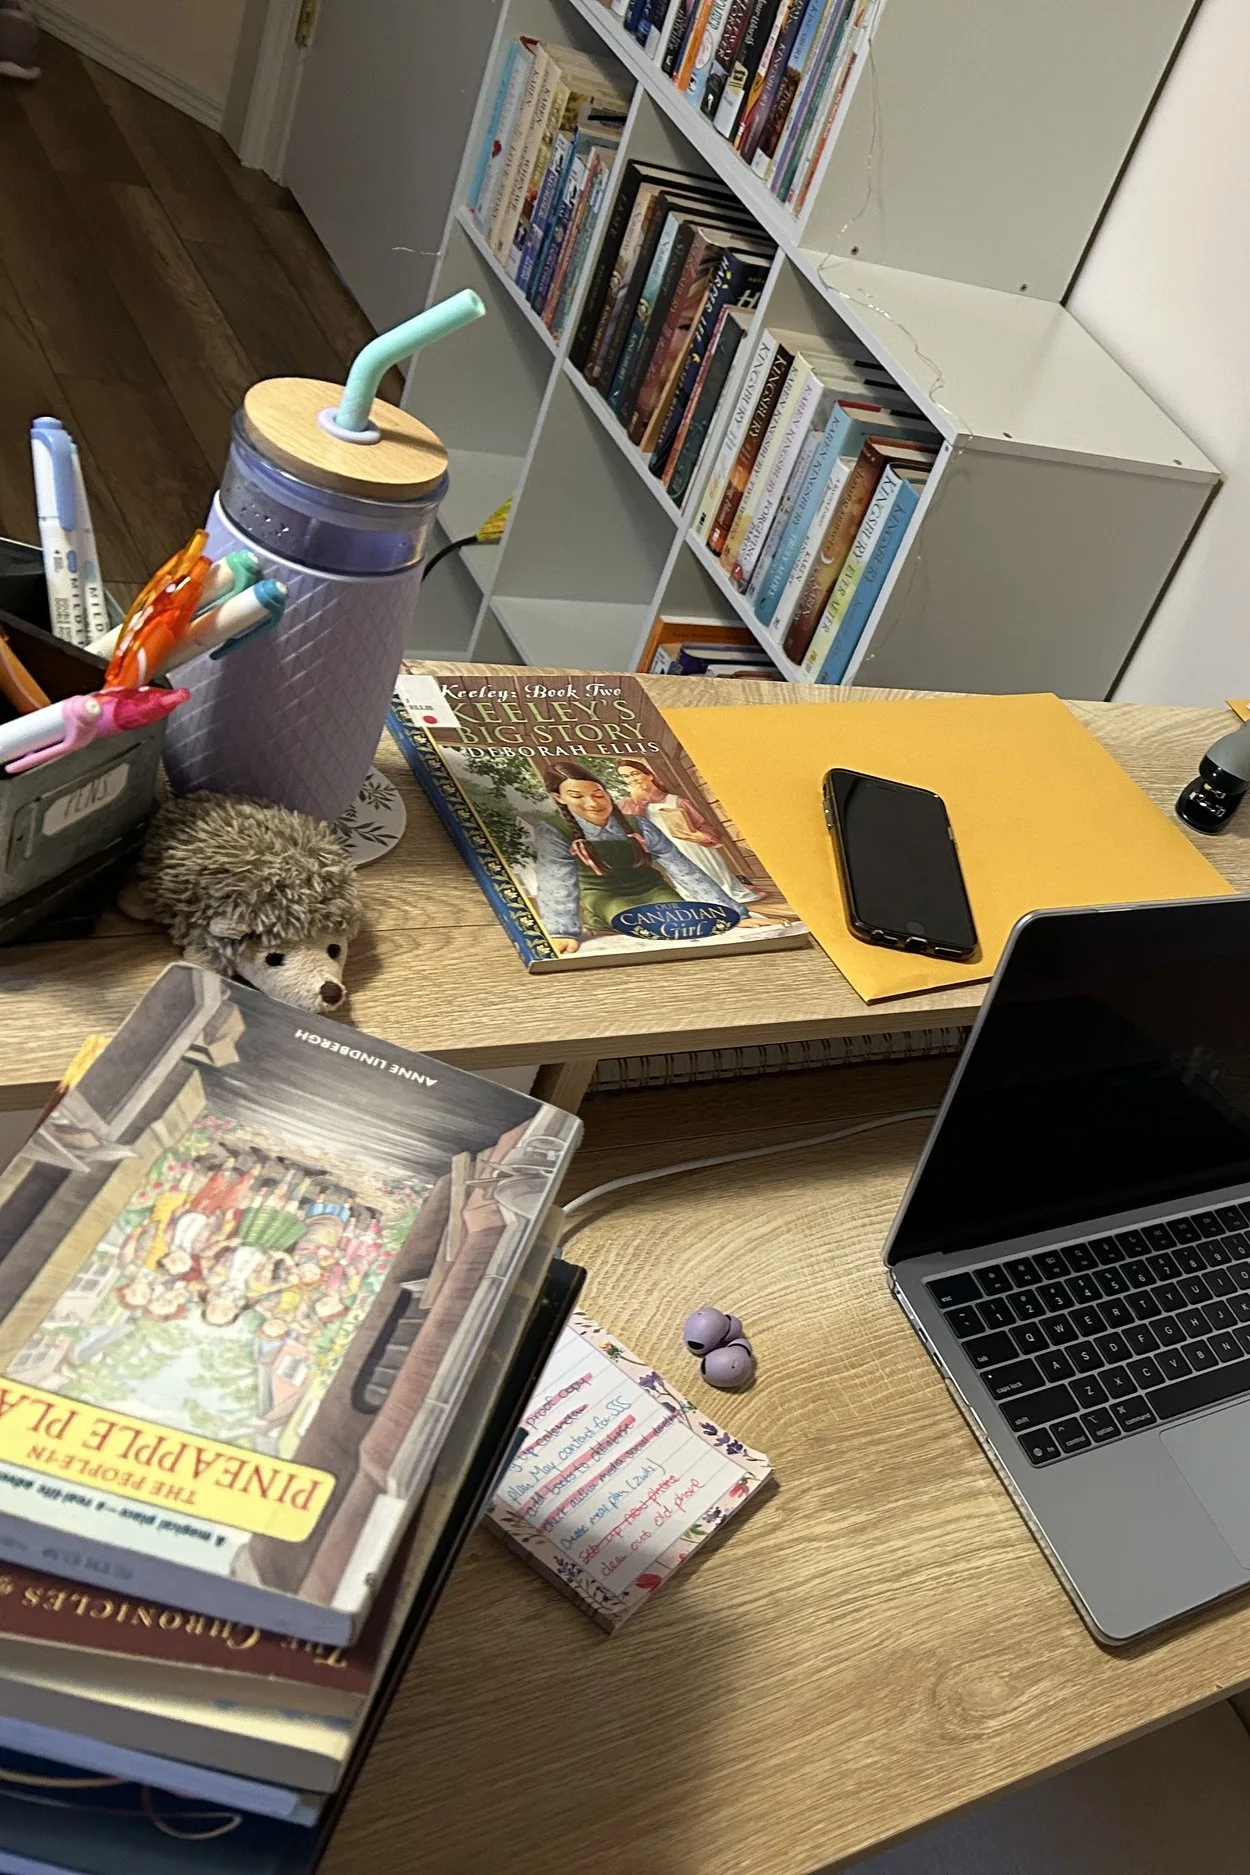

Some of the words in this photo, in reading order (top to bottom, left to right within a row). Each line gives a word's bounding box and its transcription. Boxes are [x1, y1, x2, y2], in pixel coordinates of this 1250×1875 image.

[535, 87, 550, 126] KAREN
[704, 257, 727, 310] HARPER
[693, 316, 706, 341] LEE
[734, 343, 768, 427] KINGSBURY
[750, 355, 785, 437] KINGSBURY
[777, 365, 796, 411] KAREN
[792, 384, 811, 425] KAREN
[753, 413, 779, 477] KINGSBURY
[820, 416, 839, 457] KAREN
[766, 429, 794, 494] KINGSBURY
[791, 460, 821, 527] KINGSBURY
[842, 463, 864, 508] chasing
[745, 499, 771, 561] FORGIVING
[825, 509, 845, 553] sunsets
[852, 475, 895, 562] KINGSBURY
[865, 504, 902, 583] KINGSBURY
[795, 550, 810, 582] KAREN
[837, 564, 854, 596] EVER
[70, 577, 83, 645] MILDLI
[88, 587, 103, 632] MILD
[821, 597, 840, 633] AFTER
[440, 683, 516, 702] Keeley:
[525, 684, 578, 698] Book
[585, 684, 621, 696] Two
[450, 700, 636, 722] KEELEY'S
[454, 726, 524, 743] BIG
[530, 722, 645, 742] STORY
[467, 745, 589, 758] DEBORAH
[597, 742, 661, 755] ELLIS
[619, 903, 727, 928] CANADIAN
[655, 901, 680, 911] OUR
[659, 918, 709, 940] Girl
[293, 1028, 387, 1069] LINDBERGH
[387, 1062, 438, 1088] ANNE
[1085, 1316, 1092, 1324] E
[1082, 1352, 1089, 1360] S
[1143, 1368, 1150, 1376] C
[0, 1387, 79, 1443] PLA
[526, 1394, 556, 1430] proof
[555, 1374, 591, 1404] copy
[25, 1442, 62, 1465] IN
[62, 1452, 147, 1492] PEOPLE
[80, 1415, 322, 1512] PINEAPPLE
[525, 1494, 548, 1516] add
[575, 1461, 590, 1475] to
[590, 1422, 634, 1459] database
[34, 1481, 93, 1509] real-life
[148, 1478, 197, 1505] THE
[507, 1478, 535, 1504] plan
[530, 1458, 559, 1484] May
[542, 1508, 568, 1531] check
[597, 1457, 624, 1481] media
[626, 1437, 649, 1457] social
[606, 1483, 631, 1507] plan
[157, 1516, 212, 1543] magical
[605, 1526, 625, 1546] up
[624, 1502, 648, 1524] new
[648, 1473, 682, 1505] phone
[628, 1528, 651, 1549] out
[651, 1505, 673, 1526] old
[672, 1477, 708, 1511] phone
[19, 1584, 261, 1653] CHRONICLES
